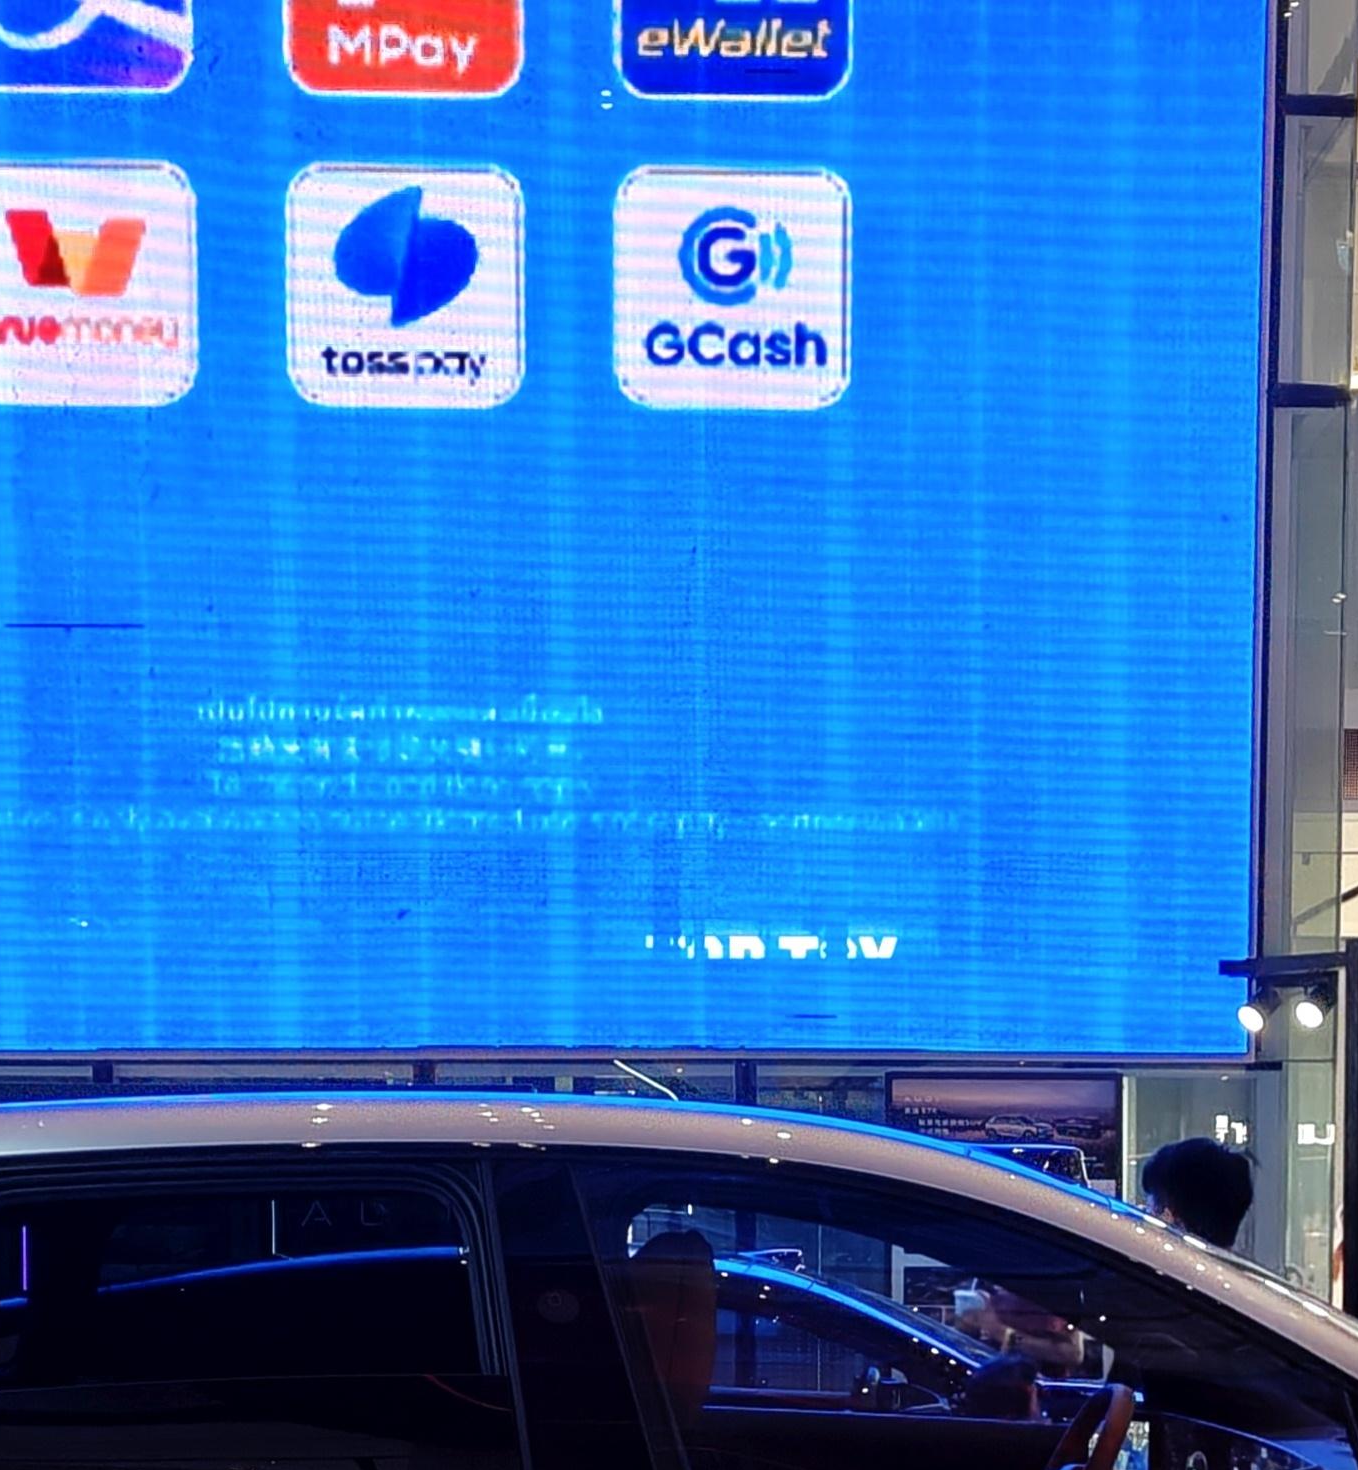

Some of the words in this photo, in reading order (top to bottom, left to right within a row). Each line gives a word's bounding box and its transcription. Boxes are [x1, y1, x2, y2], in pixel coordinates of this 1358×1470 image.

[328, 24, 477, 76] MPay
[637, 18, 832, 58] eWallet
[644, 321, 828, 368] GCash
